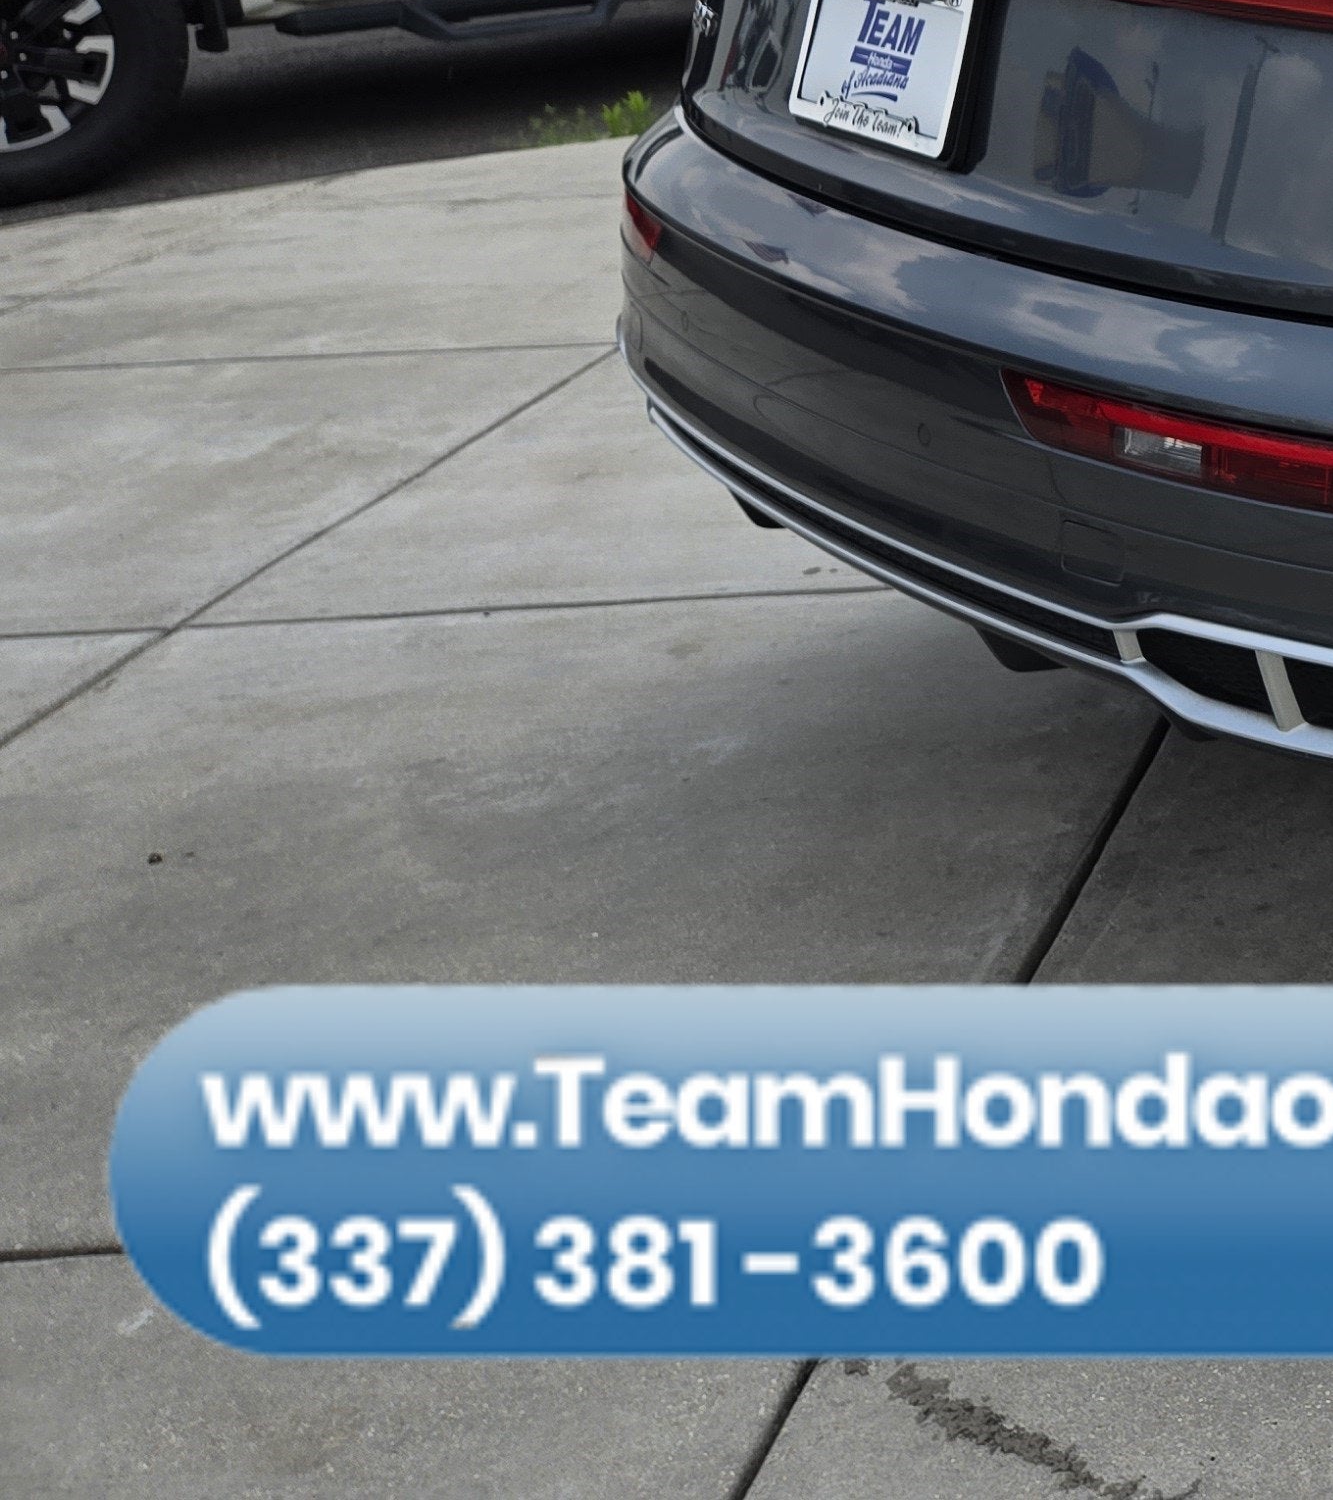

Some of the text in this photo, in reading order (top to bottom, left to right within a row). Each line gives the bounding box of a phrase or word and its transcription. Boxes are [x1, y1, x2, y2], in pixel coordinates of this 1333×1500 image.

[868, 51, 893, 69] Honda
[841, 63, 909, 99] of Acadiana
[823, 99, 904, 137] Join The Team!
